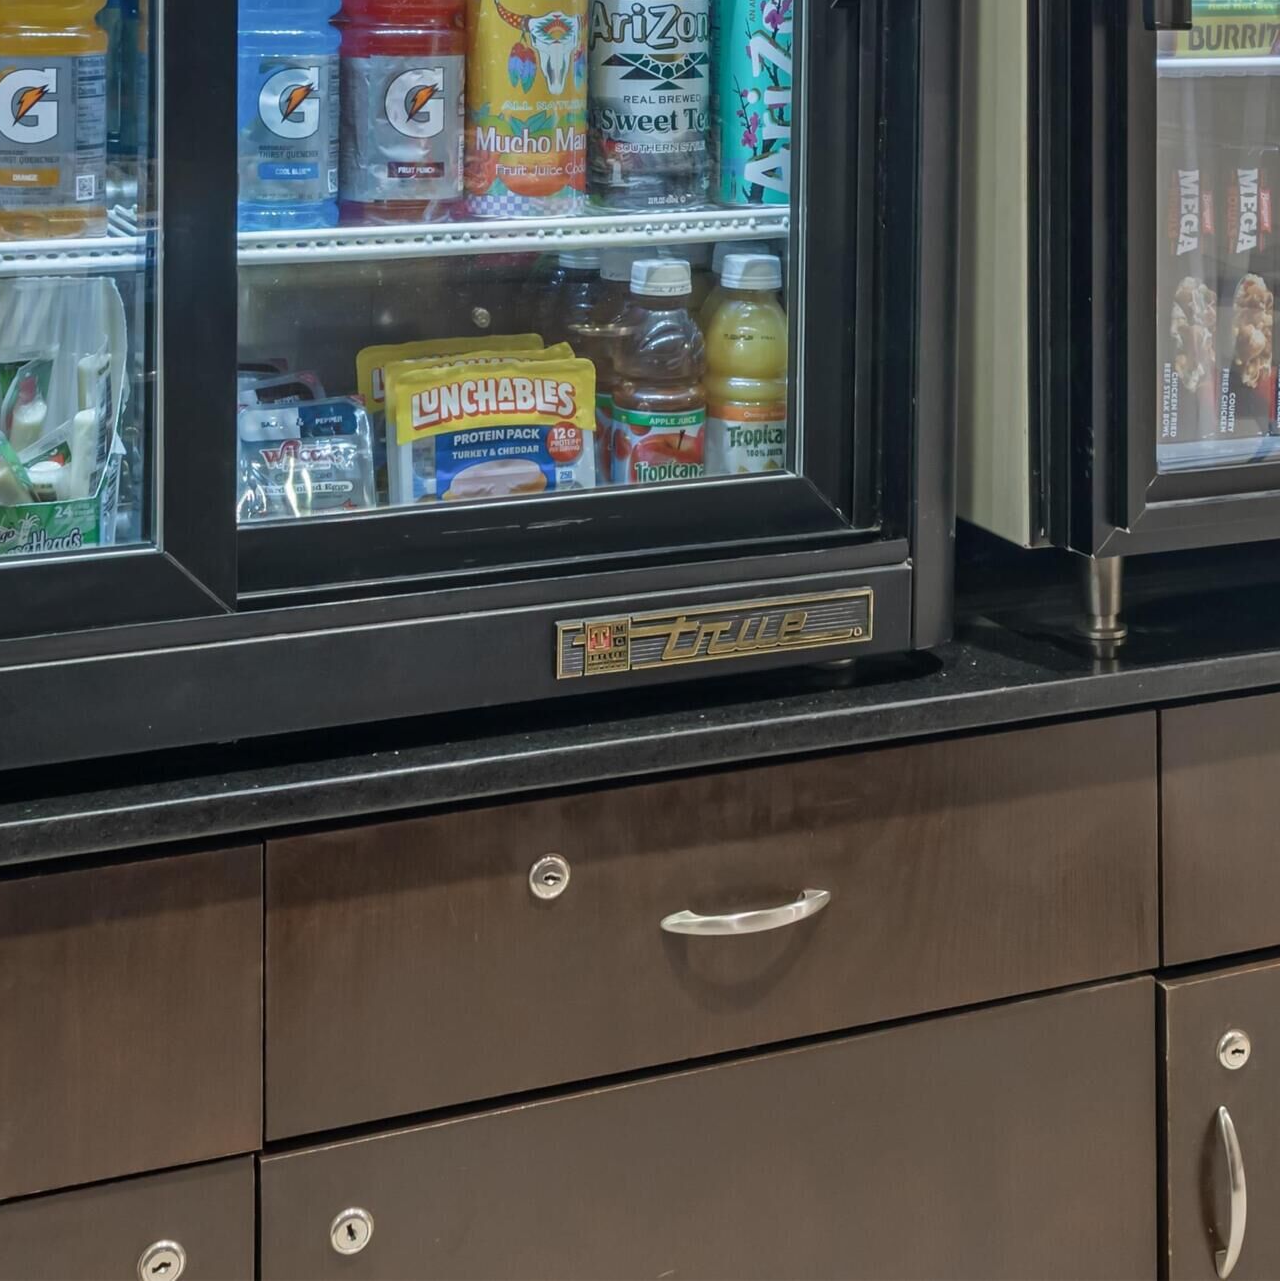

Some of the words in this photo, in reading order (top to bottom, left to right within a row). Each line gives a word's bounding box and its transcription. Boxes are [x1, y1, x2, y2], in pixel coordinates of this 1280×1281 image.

[258, 66, 319, 139] G
[384, 67, 444, 138] G
[623, 95, 656, 104] REAL
[658, 94, 702, 104] BREWED
[476, 126, 551, 153] Mucho
[1176, 169, 1199, 256] MEGA
[1236, 168, 1258, 254] MEGA
[1171, 371, 1179, 410] CHICKEN
[1222, 367, 1230, 393] FRIED
[412, 378, 576, 429] LUNCHABLES
[649, 417, 675, 426] APPLE
[676, 416, 696, 424] JUICE
[1220, 394, 1228, 433] CHICKEN
[1228, 392, 1236, 433] COUNTRY
[452, 449, 488, 460] TURKEY
[489, 448, 496, 456] &
[497, 445, 540, 455] CHEDDAR
[453, 430, 506, 447] PROTEIN
[506, 428, 540, 440] PACK
[55, 505, 73, 518] 24
